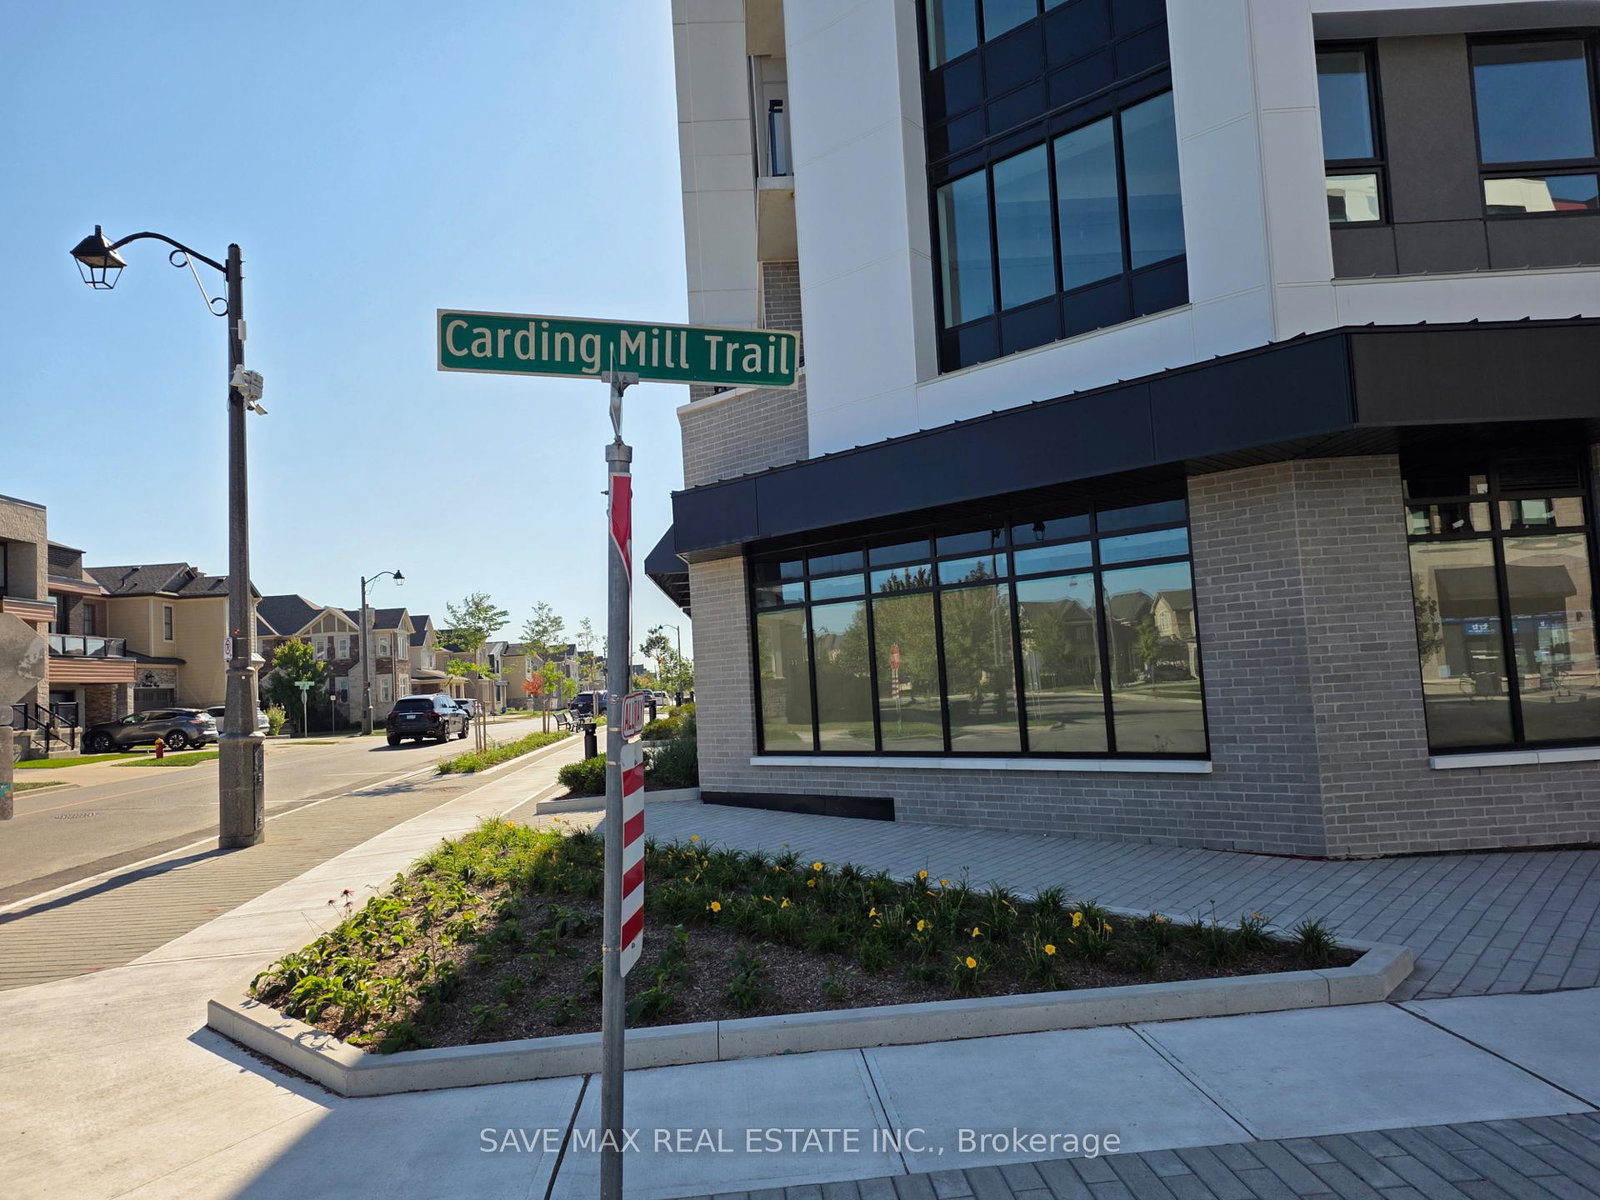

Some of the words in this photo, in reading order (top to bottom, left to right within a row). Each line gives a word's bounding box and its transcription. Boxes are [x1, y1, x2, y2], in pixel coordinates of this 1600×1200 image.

[446, 320, 601, 374] Carding
[619, 328, 689, 369] Mill
[704, 335, 790, 375] Trail
